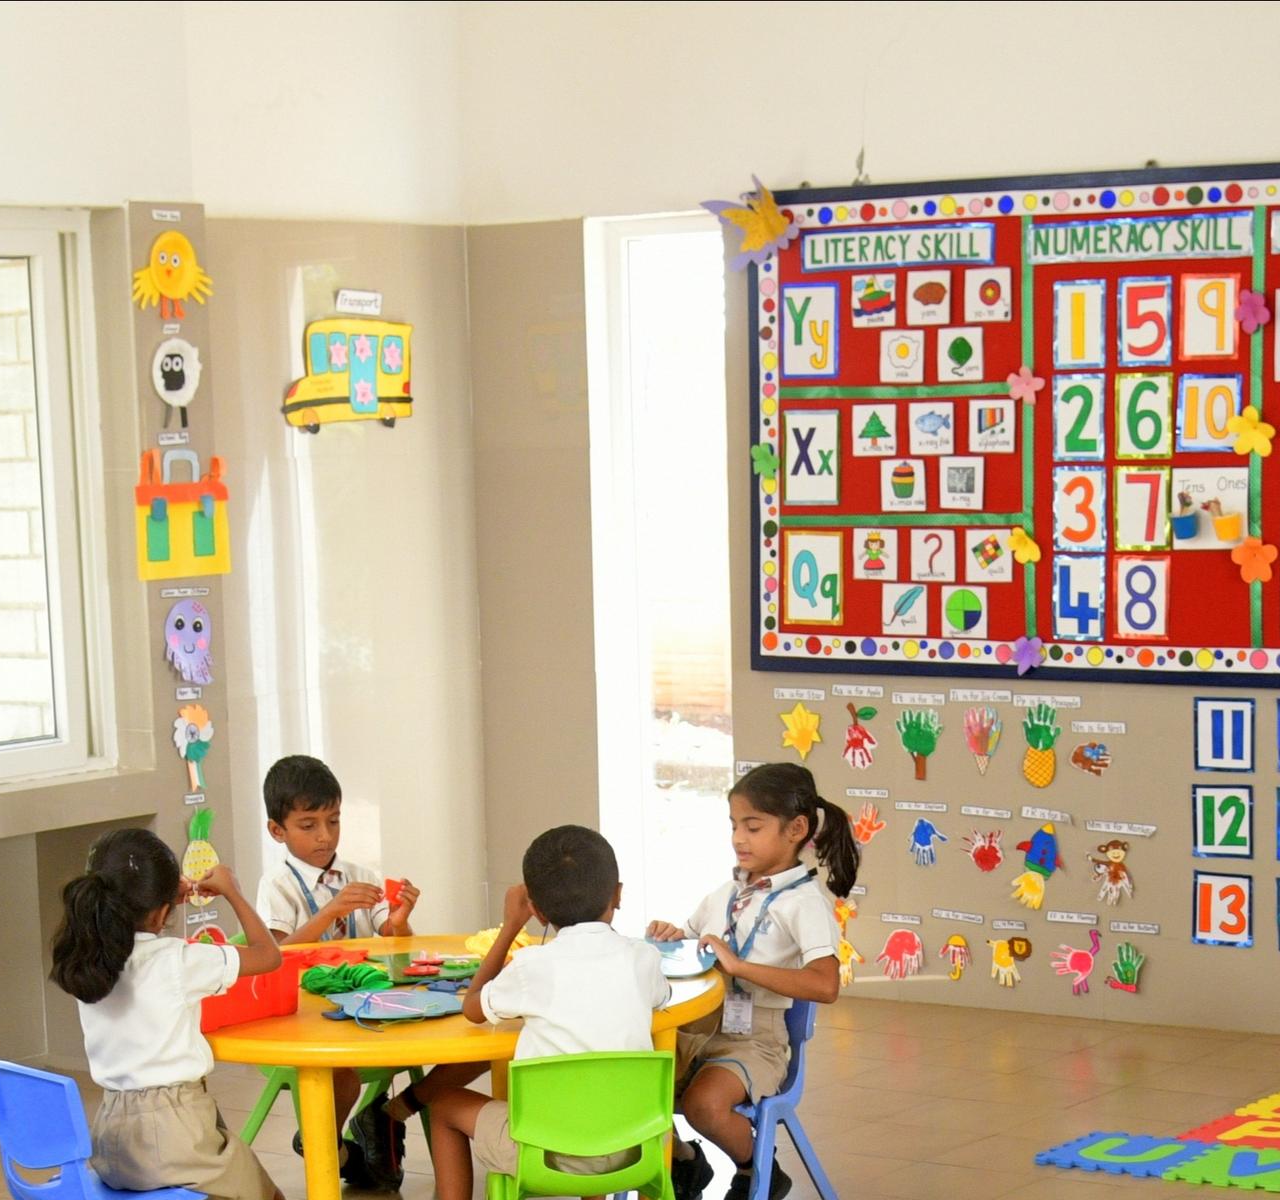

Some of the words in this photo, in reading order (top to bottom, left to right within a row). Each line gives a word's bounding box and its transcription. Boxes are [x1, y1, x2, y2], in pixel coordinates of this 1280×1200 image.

[810, 234, 910, 265] LITERACY
[916, 232, 980, 260] SKILL
[1033, 219, 1172, 256] NUMERACY
[1173, 216, 1242, 250] SKILL
[785, 296, 829, 369] Yy
[1071, 292, 1085, 360] 1
[1126, 285, 1166, 357] 5
[1197, 281, 1226, 351] 9
[1061, 385, 1097, 452] 2
[1126, 380, 1162, 450] 6
[1183, 385, 1234, 439] 10
[791, 427, 834, 476] Xx
[1062, 476, 1097, 542] 3
[1125, 474, 1161, 541] 7
[1179, 479, 1206, 493] Tens
[1217, 477, 1247, 492] Ones
[792, 549, 840, 620] Qq
[1059, 565, 1099, 634] 4
[1125, 565, 1157, 630] 8
[1212, 710, 1244, 760] 11
[1202, 795, 1248, 847] 12
[1198, 883, 1247, 935] 13
[1078, 1137, 1187, 1163] U
